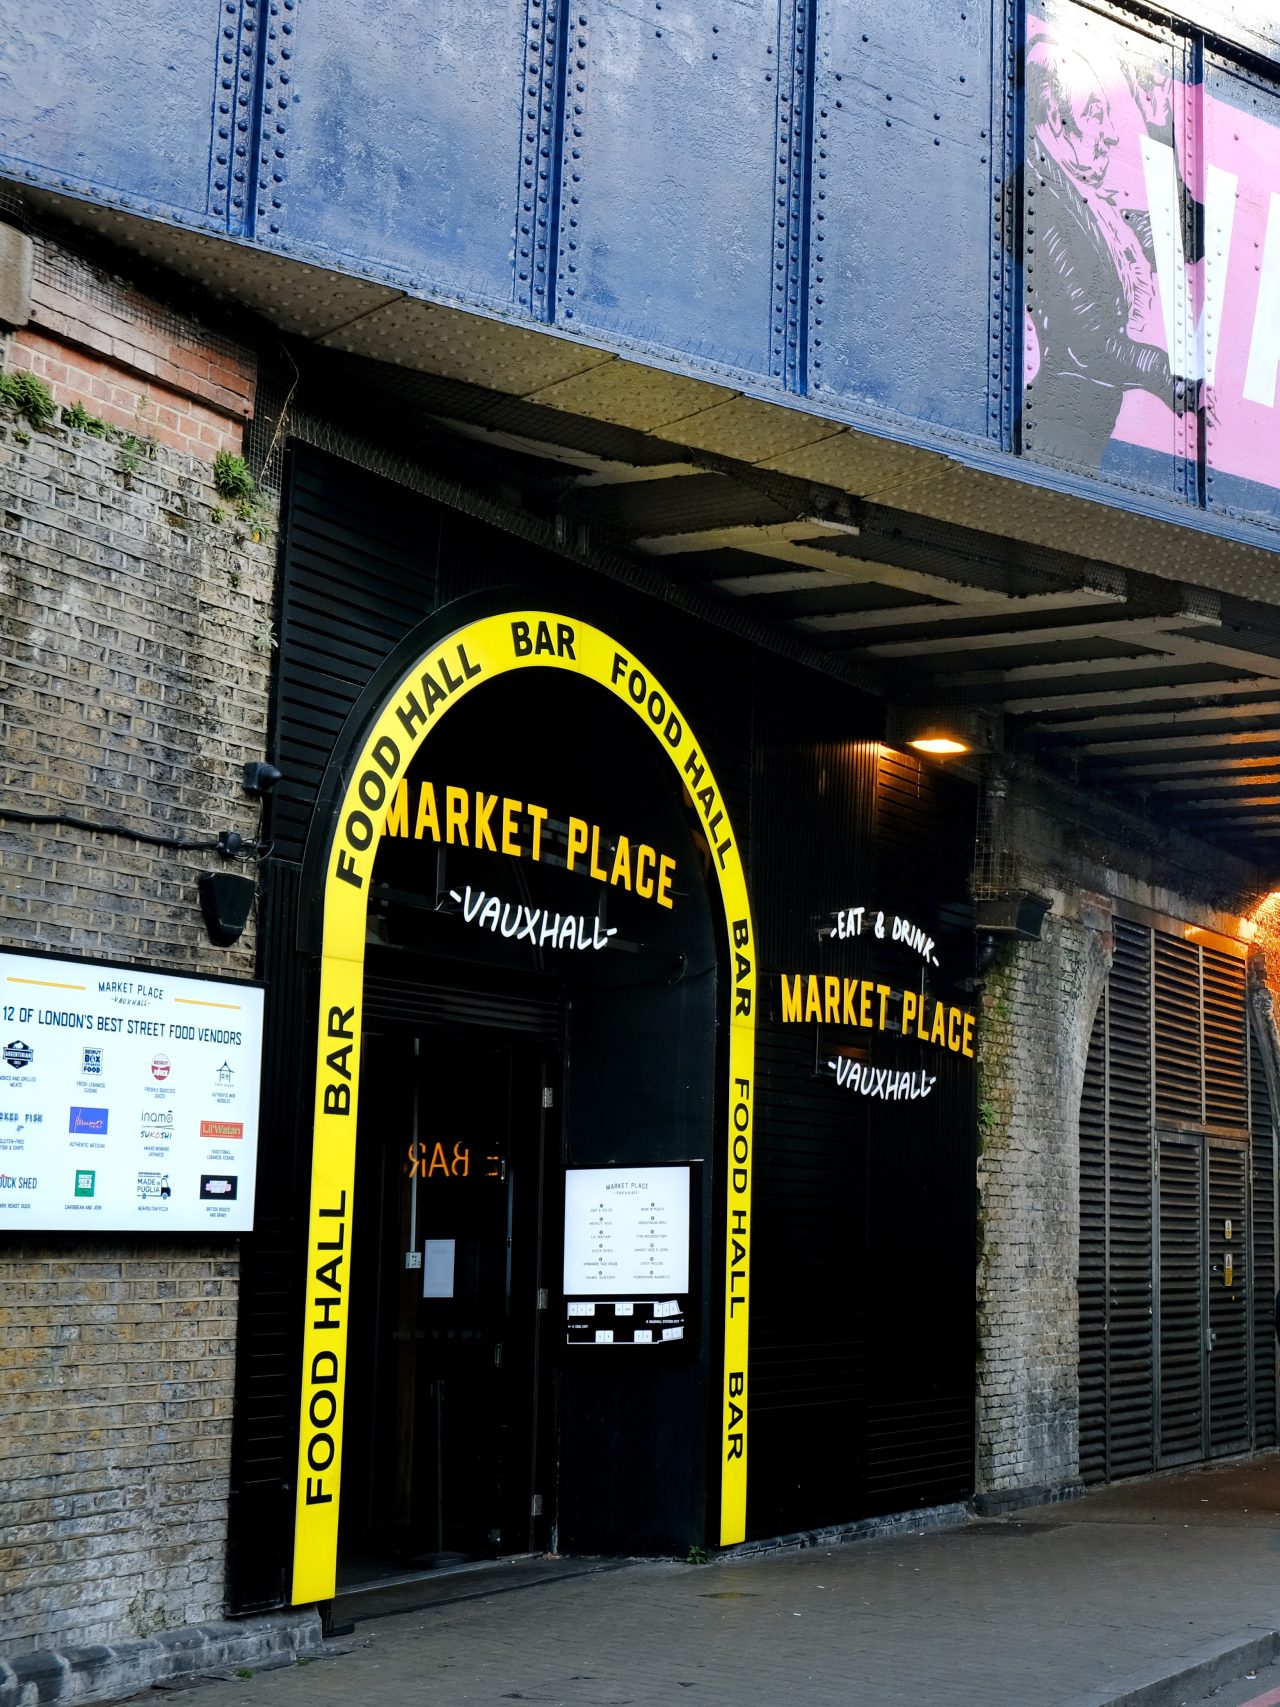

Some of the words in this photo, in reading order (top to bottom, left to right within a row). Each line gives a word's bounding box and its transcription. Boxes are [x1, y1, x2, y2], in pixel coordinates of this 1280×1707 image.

[510, 620, 577, 660] BAR
[395, 643, 482, 741] HALL
[610, 652, 682, 748] FOOD
[335, 735, 401, 889] FOOD
[380, 778, 548, 861] MARKET
[567, 816, 676, 909] PLACE
[683, 748, 732, 872] HALL
[732, 918, 751, 1016] BAR
[874, 911, 885, 939] &
[3, 1006, 15, 1021] 12
[19, 1007, 34, 1023] OF
[39, 1010, 93, 1030] LONDON'S
[97, 1016, 123, 1033] BEST
[127, 1019, 166, 1037] STREET
[170, 1024, 195, 1040] FOOD
[198, 1027, 242, 1045] VENDORS
[98, 982, 133, 994] MARKET
[137, 983, 163, 1000] PLACE
[781, 974, 890, 1030] MARKET
[902, 990, 976, 1058] PLACE
[324, 1005, 355, 1116] BAR
[18, 1177, 38, 1189] SHED
[137, 1178, 156, 1186] MADE
[733, 1078, 749, 1194] FOOD
[137, 1185, 160, 1194] PUGLIA
[605, 1182, 628, 1191] MARKET
[631, 1182, 649, 1190] PLACE
[314, 1190, 346, 1329] HALL
[730, 1210, 747, 1319] HALL
[306, 1350, 338, 1506] FOOD
[727, 1372, 744, 1462] BAR
